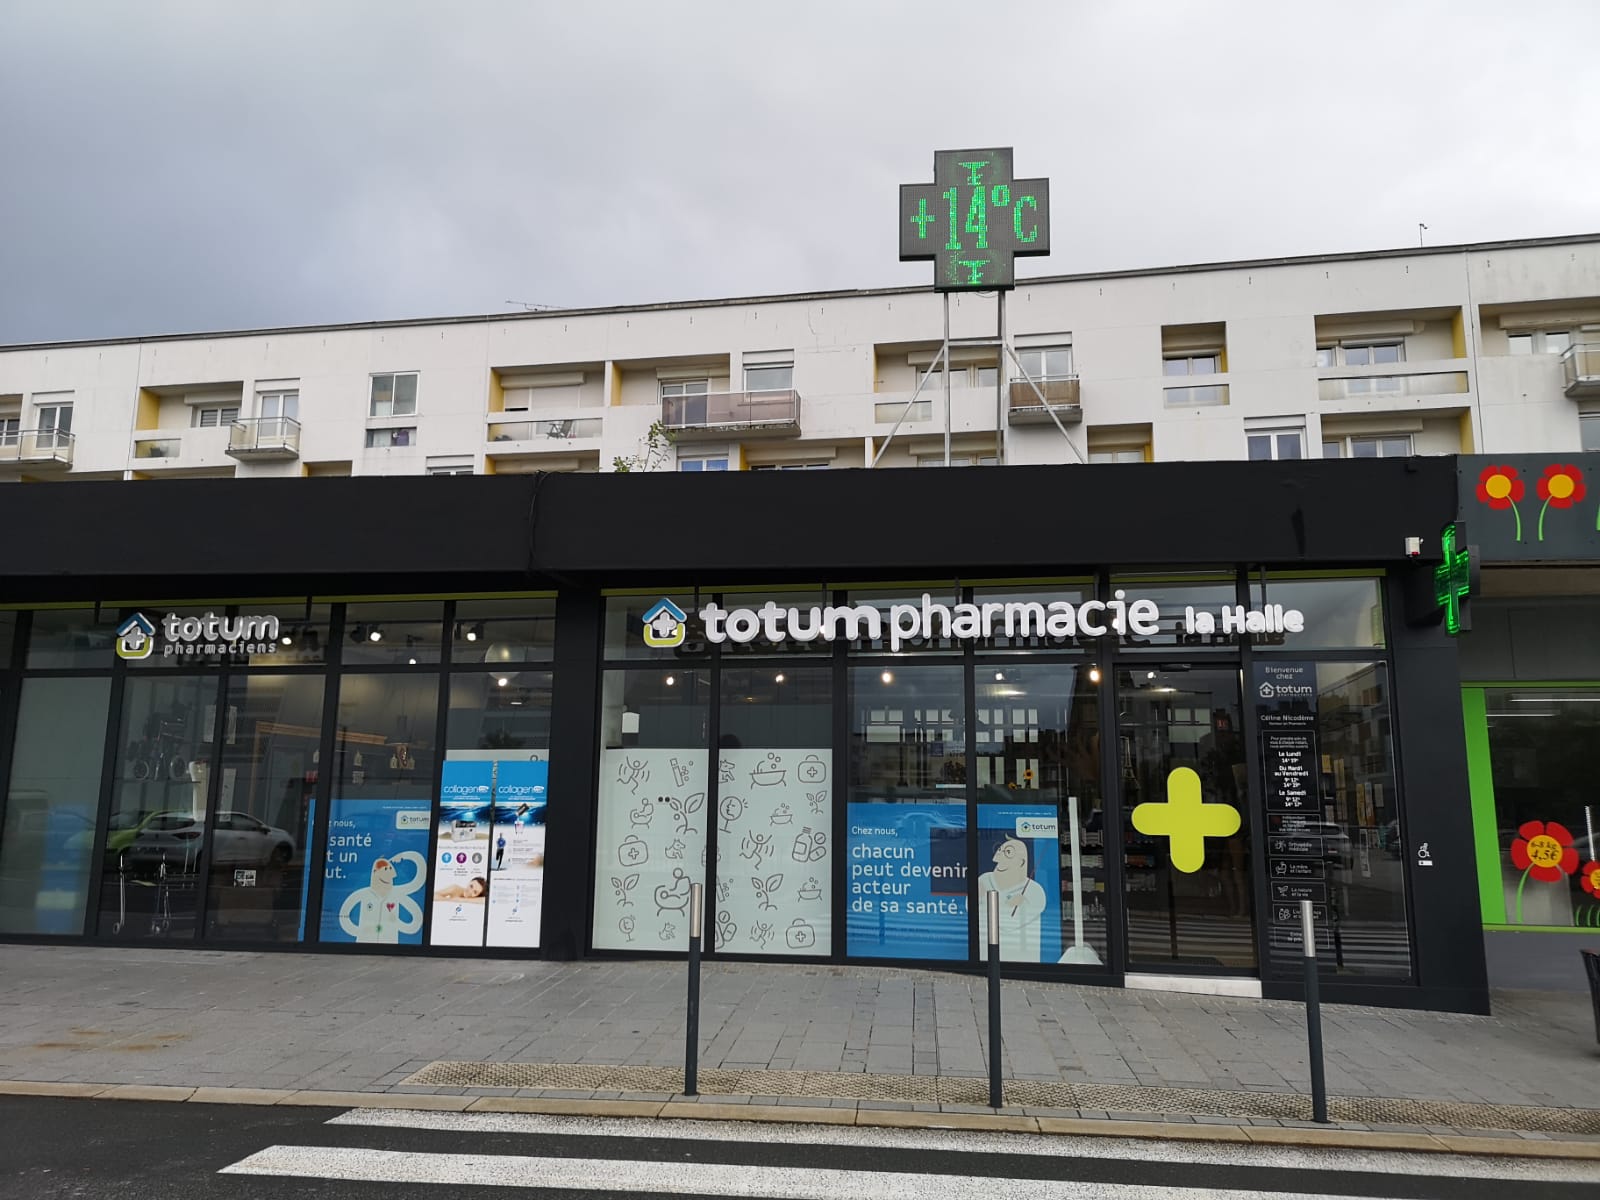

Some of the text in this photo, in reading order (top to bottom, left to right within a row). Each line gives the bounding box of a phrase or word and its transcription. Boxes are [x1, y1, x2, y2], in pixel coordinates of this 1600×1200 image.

[161, 611, 280, 642] totum
[700, 589, 1304, 652] totum pharmacie la Halle
[163, 641, 277, 657] pharmaciens
[1275, 684, 1312, 693] totum
[333, 820, 356, 829] nous,
[851, 826, 898, 837] Chez nous,
[329, 832, 372, 847] santé
[339, 852, 357, 862] un
[852, 843, 914, 859] chacun
[852, 862, 968, 880] peut devenir
[852, 880, 911, 895] acteur
[851, 897, 964, 915] de sa santé.
